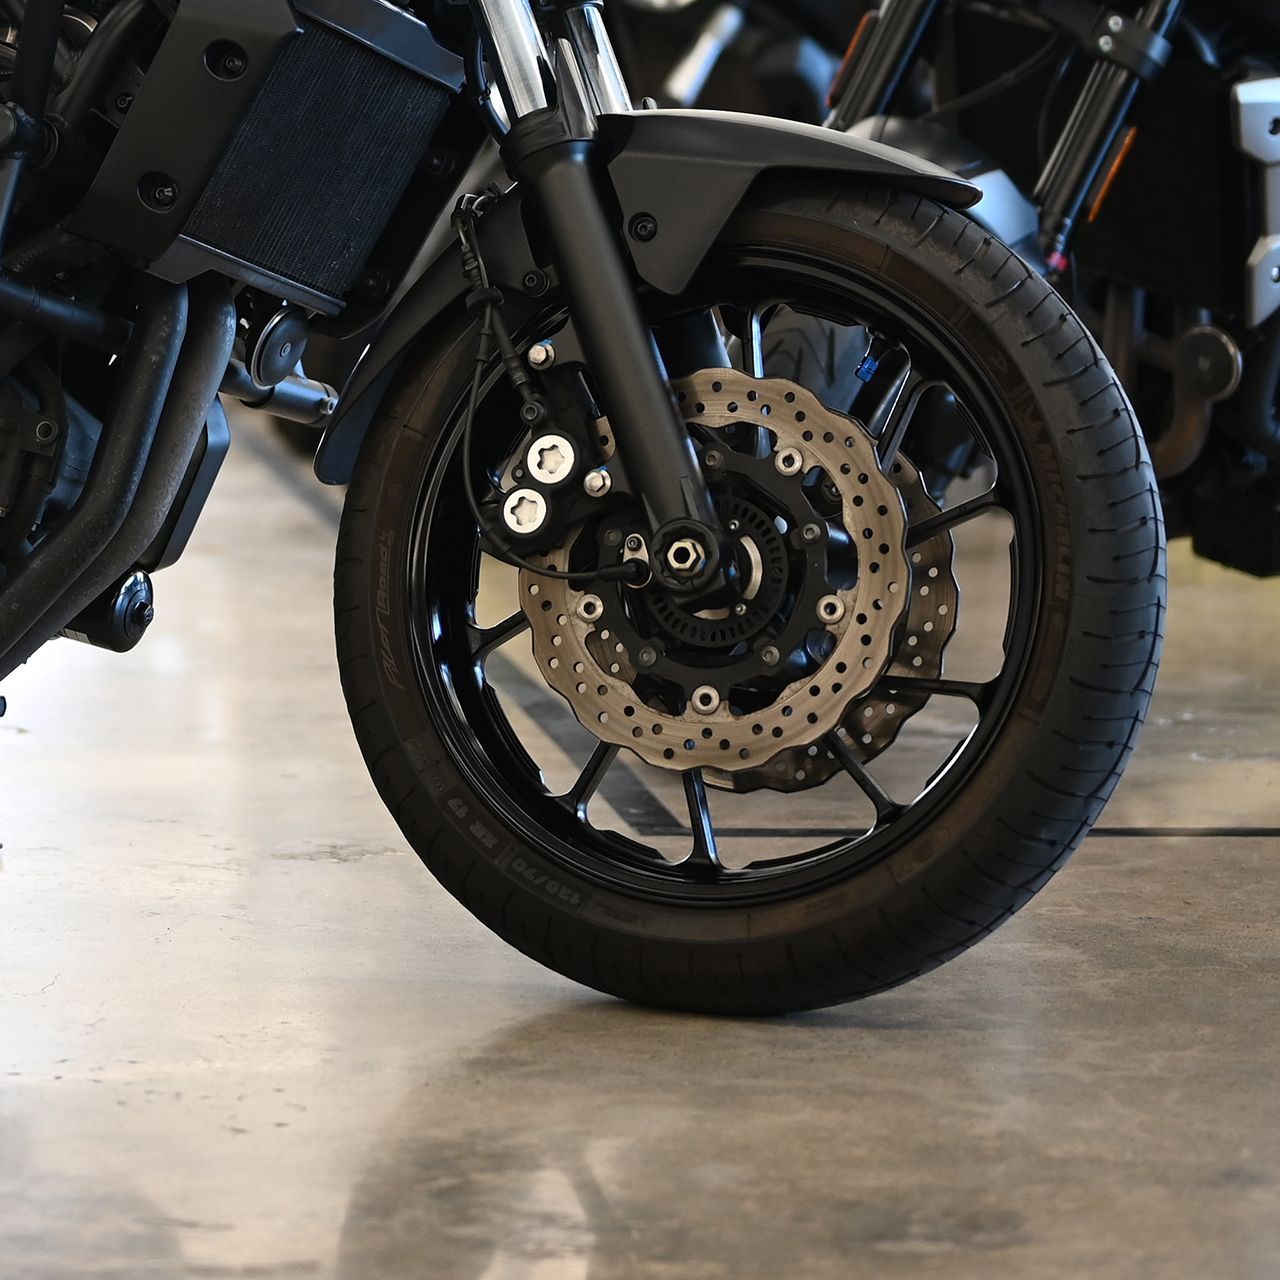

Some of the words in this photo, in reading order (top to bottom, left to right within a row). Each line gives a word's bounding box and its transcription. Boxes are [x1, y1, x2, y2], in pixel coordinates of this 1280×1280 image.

[445, 797, 470, 818] 17
[467, 819, 500, 849] ZR
[510, 856, 582, 906] 120/70
